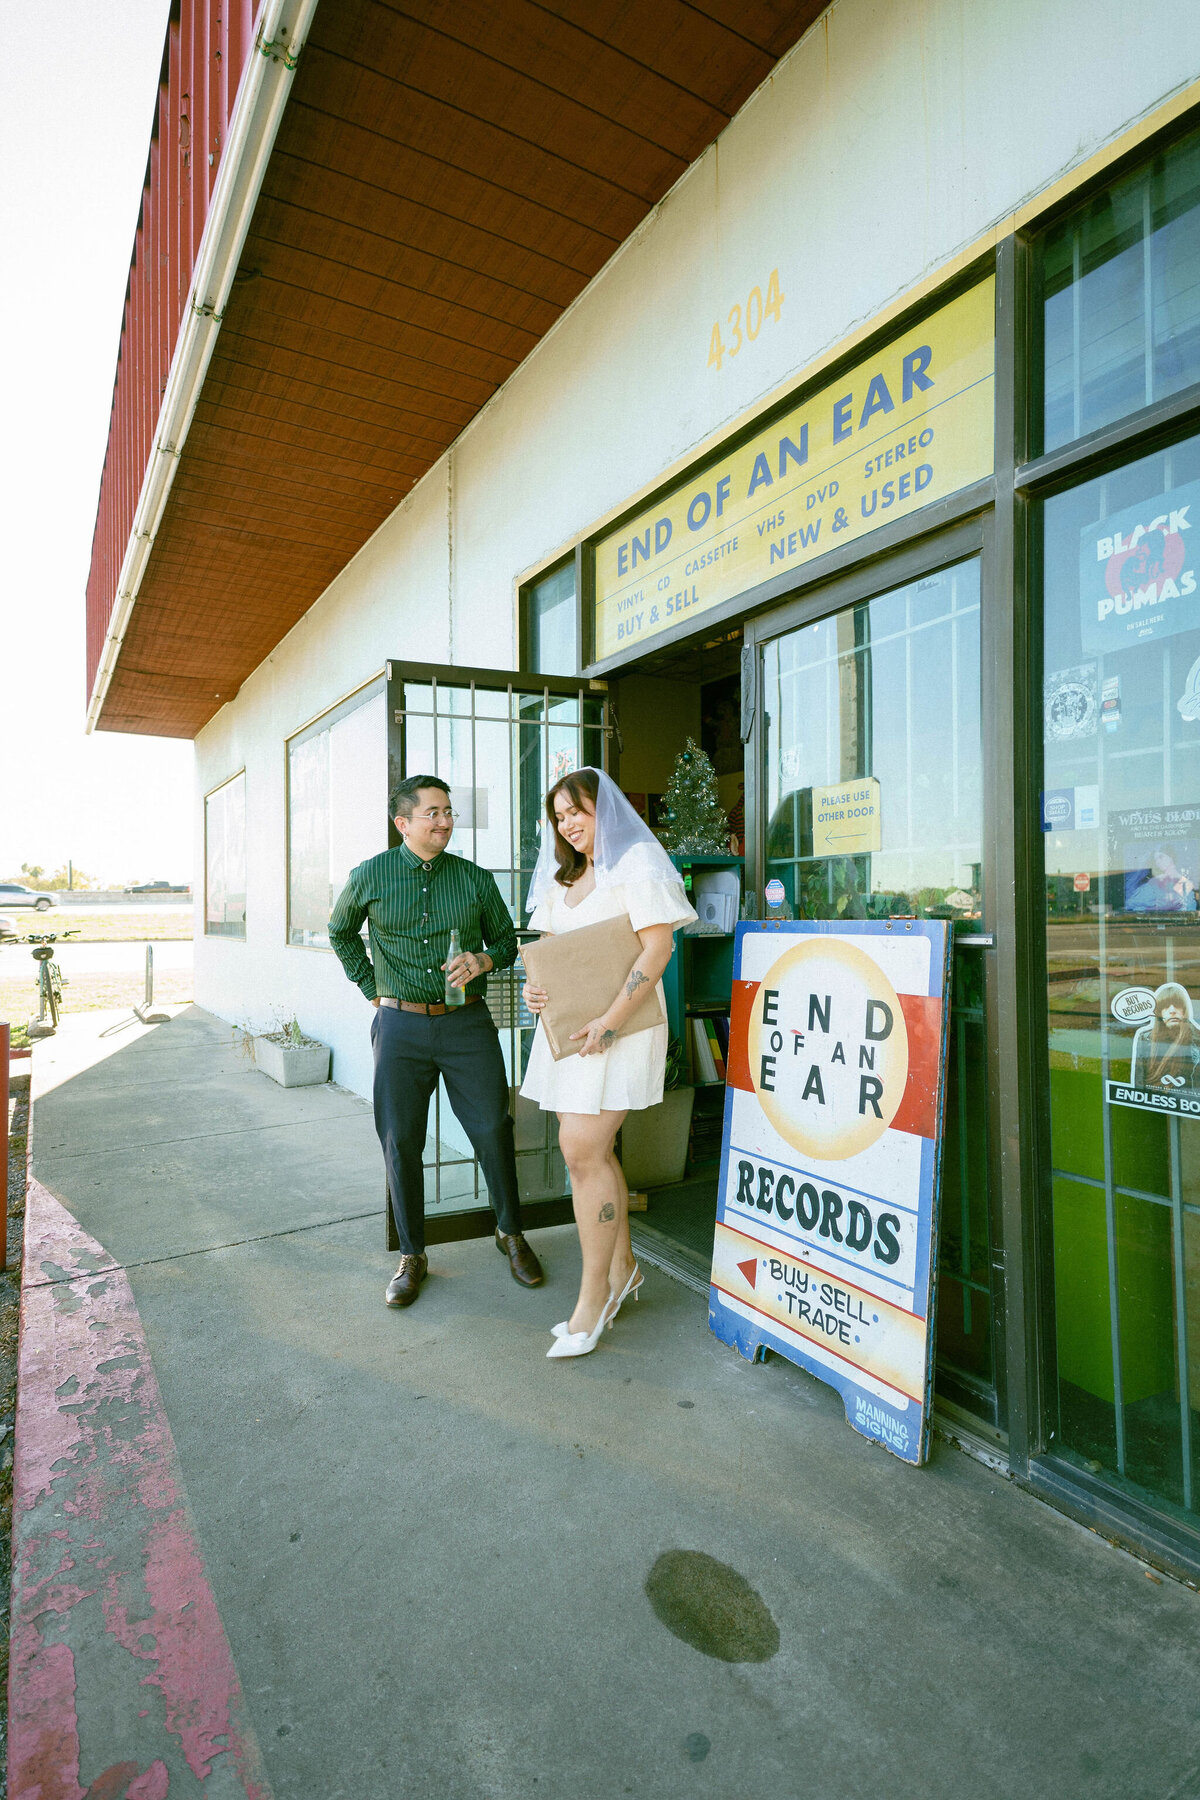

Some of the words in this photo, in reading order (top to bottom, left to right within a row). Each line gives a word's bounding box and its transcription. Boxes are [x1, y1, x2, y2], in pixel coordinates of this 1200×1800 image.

[707, 267, 785, 372] 4304
[616, 516, 673, 578] END
[686, 475, 732, 533] OF
[746, 422, 809, 500] AN
[832, 344, 936, 447] EAR
[616, 588, 645, 614] VINYL
[657, 575, 671, 592] CD
[684, 536, 740, 578] CASSETTE
[756, 510, 786, 537] VHS
[805, 480, 840, 511] DVD
[863, 427, 935, 480] STEREO
[1096, 504, 1192, 562] BLACK
[616, 611, 645, 641] BUY
[649, 604, 661, 624] &
[665, 584, 700, 617] SELL
[768, 518, 823, 566] NEW
[831, 506, 850, 533] &
[860, 463, 935, 519] USED
[1097, 569, 1198, 622] PUMAS
[817, 810, 845, 823] OTHER
[847, 806, 875, 820] DOOR
[821, 793, 851, 807] PLEASE
[853, 790, 871, 802] USE
[762, 989, 894, 1042] END
[1122, 999, 1153, 1017] RECORDS
[1125, 993, 1140, 1006] BUY
[770, 1030, 805, 1056] OF
[830, 1041, 875, 1071] AN
[760, 1054, 884, 1119] EAR
[1115, 1088, 1178, 1109] ENDLESS
[736, 1160, 901, 1265] RECORDS
[769, 1258, 808, 1294] BUY
[819, 1283, 870, 1326] SELL
[784, 1291, 852, 1345] TRADE
[855, 1395, 909, 1440] MANNING
